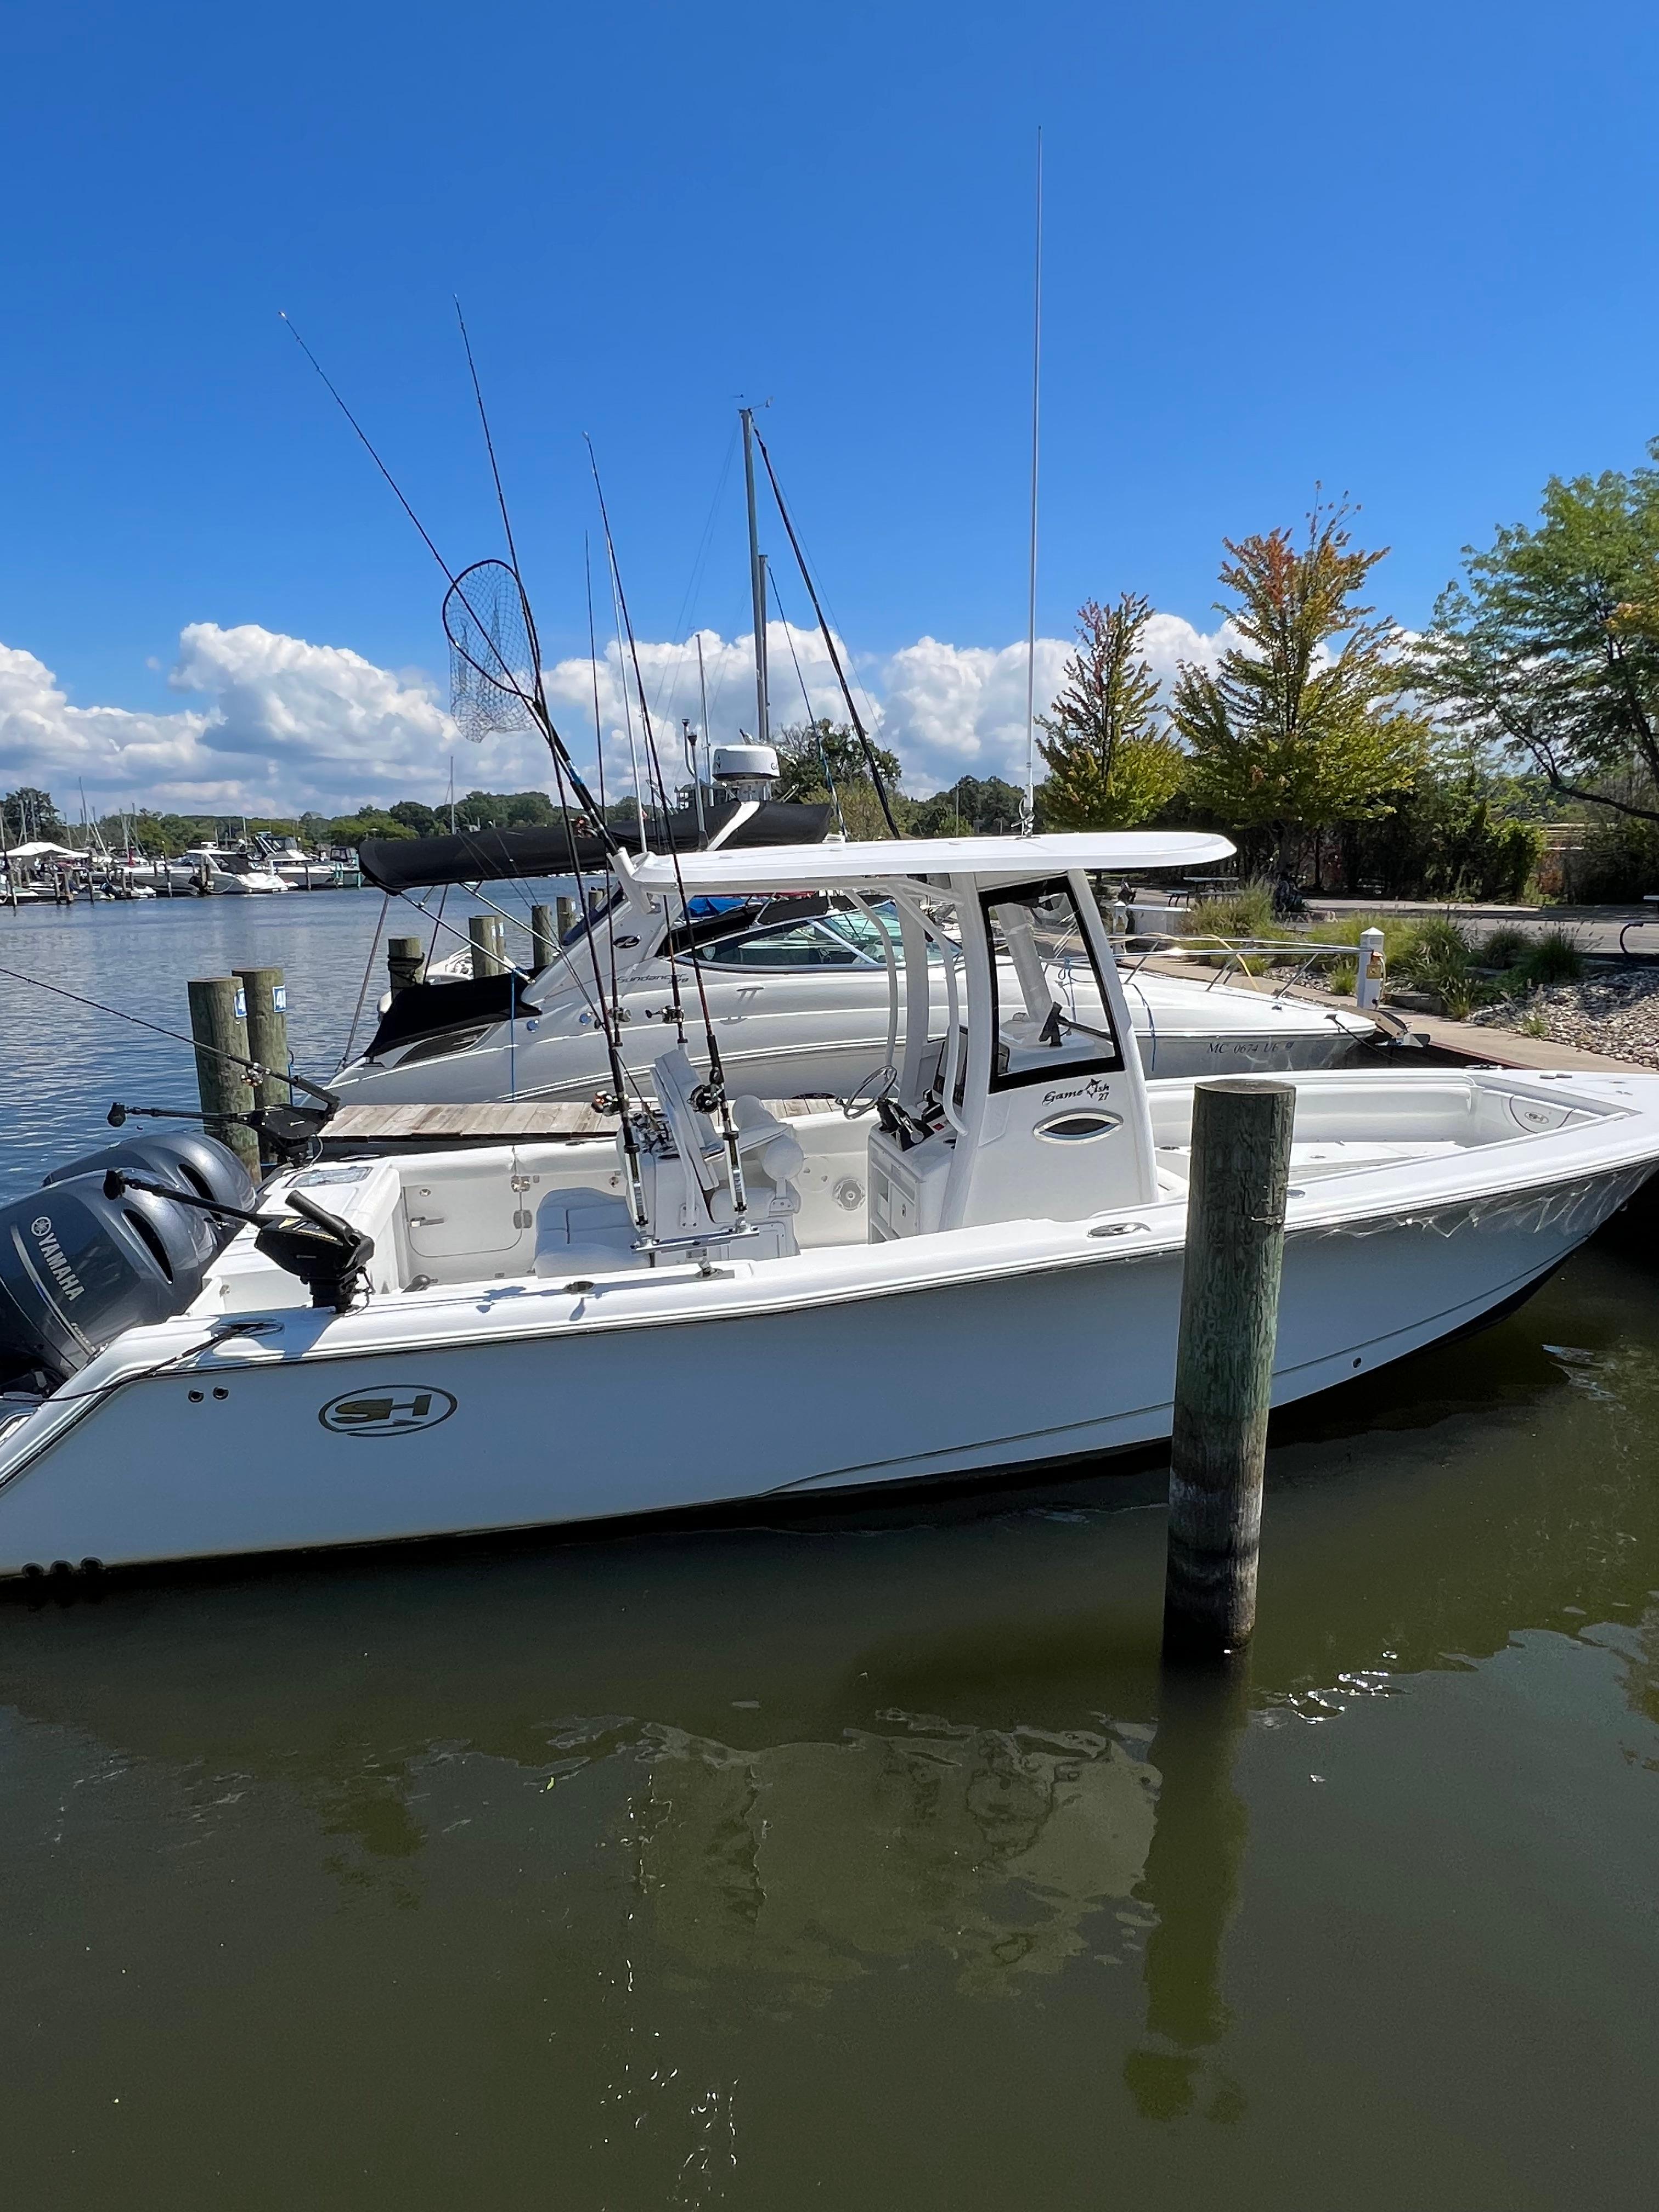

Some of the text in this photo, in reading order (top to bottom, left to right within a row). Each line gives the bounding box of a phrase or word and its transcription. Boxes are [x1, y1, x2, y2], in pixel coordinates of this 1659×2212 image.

[1208, 1043, 1228, 1053] MC
[1098, 1092, 1109, 1102] 27
[38, 1232, 84, 1301] YAMAHA
[331, 1394, 432, 1424] SH
